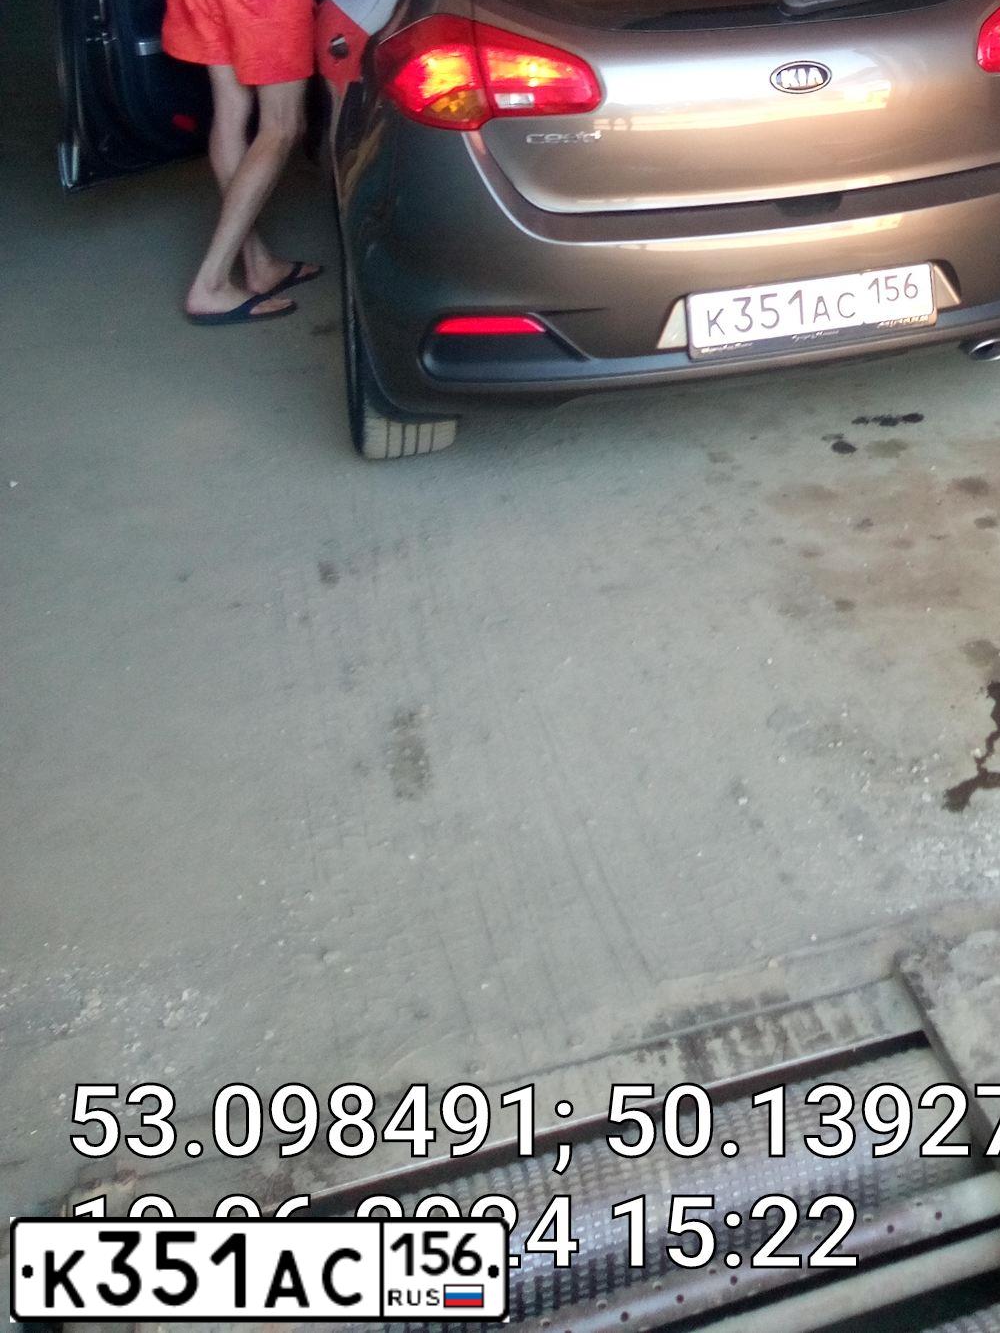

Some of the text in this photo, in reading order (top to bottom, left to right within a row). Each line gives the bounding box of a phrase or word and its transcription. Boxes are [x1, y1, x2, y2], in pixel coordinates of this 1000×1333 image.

[775, 66, 826, 91] KIA
[706, 272, 919, 338] К351АС 156
